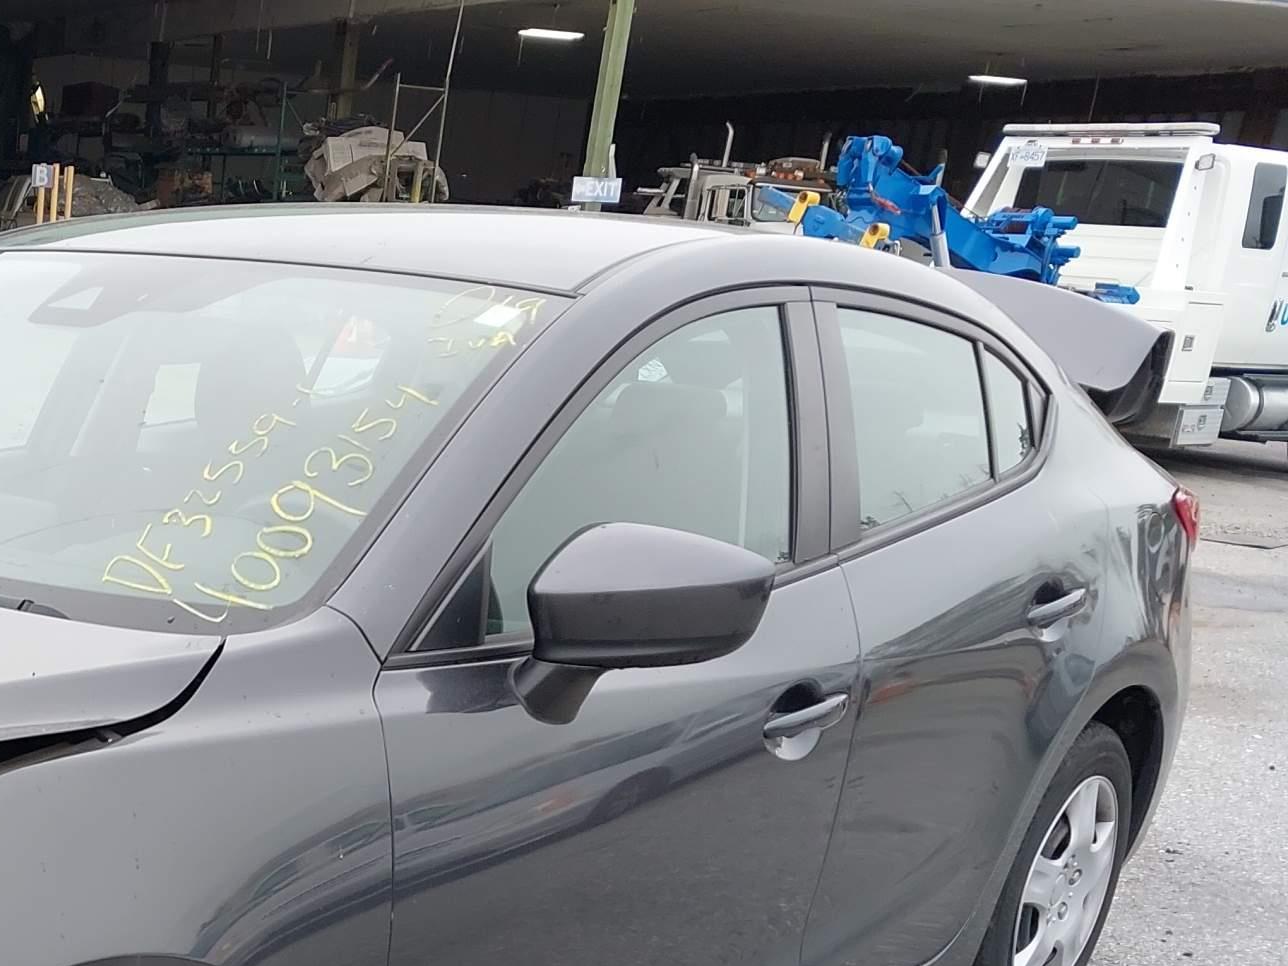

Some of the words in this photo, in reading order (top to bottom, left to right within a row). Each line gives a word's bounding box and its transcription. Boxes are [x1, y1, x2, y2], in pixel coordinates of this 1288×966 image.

[36, 164, 49, 186] B
[584, 180, 616, 197] EXIT
[170, 384, 440, 623] 40093154
